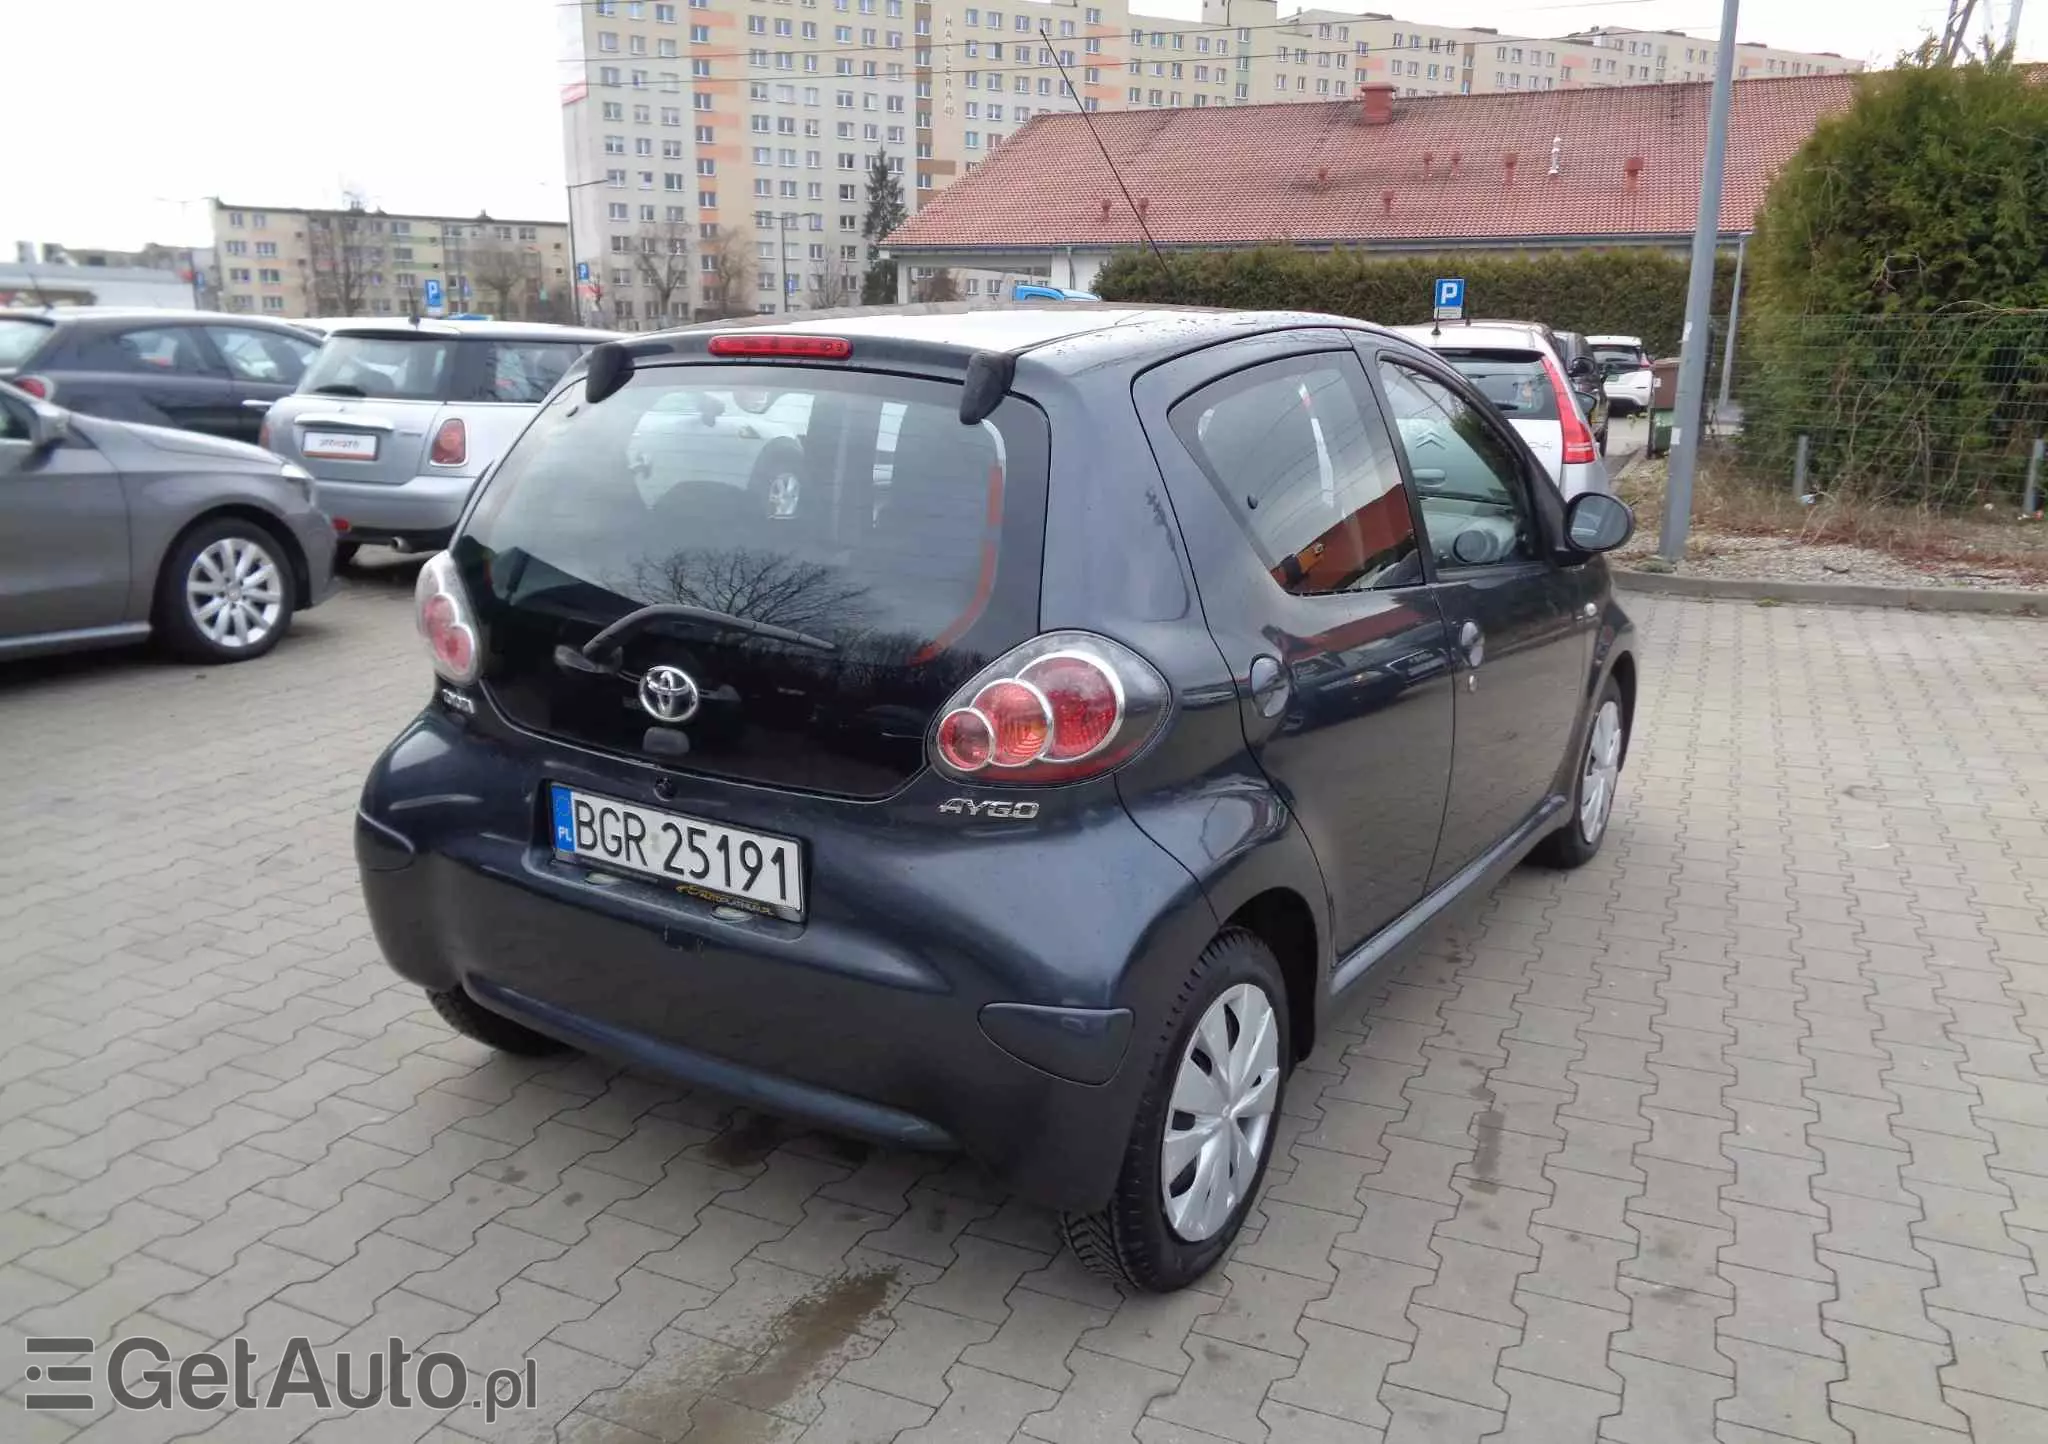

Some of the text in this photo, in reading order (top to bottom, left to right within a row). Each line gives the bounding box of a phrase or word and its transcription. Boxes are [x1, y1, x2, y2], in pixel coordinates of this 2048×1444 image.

[428, 281, 437, 299] P
[1440, 282, 1458, 305] P
[938, 797, 1040, 819] AYGO
[557, 826, 572, 842] PL
[574, 799, 649, 867] BGR
[661, 821, 787, 901] 25191
